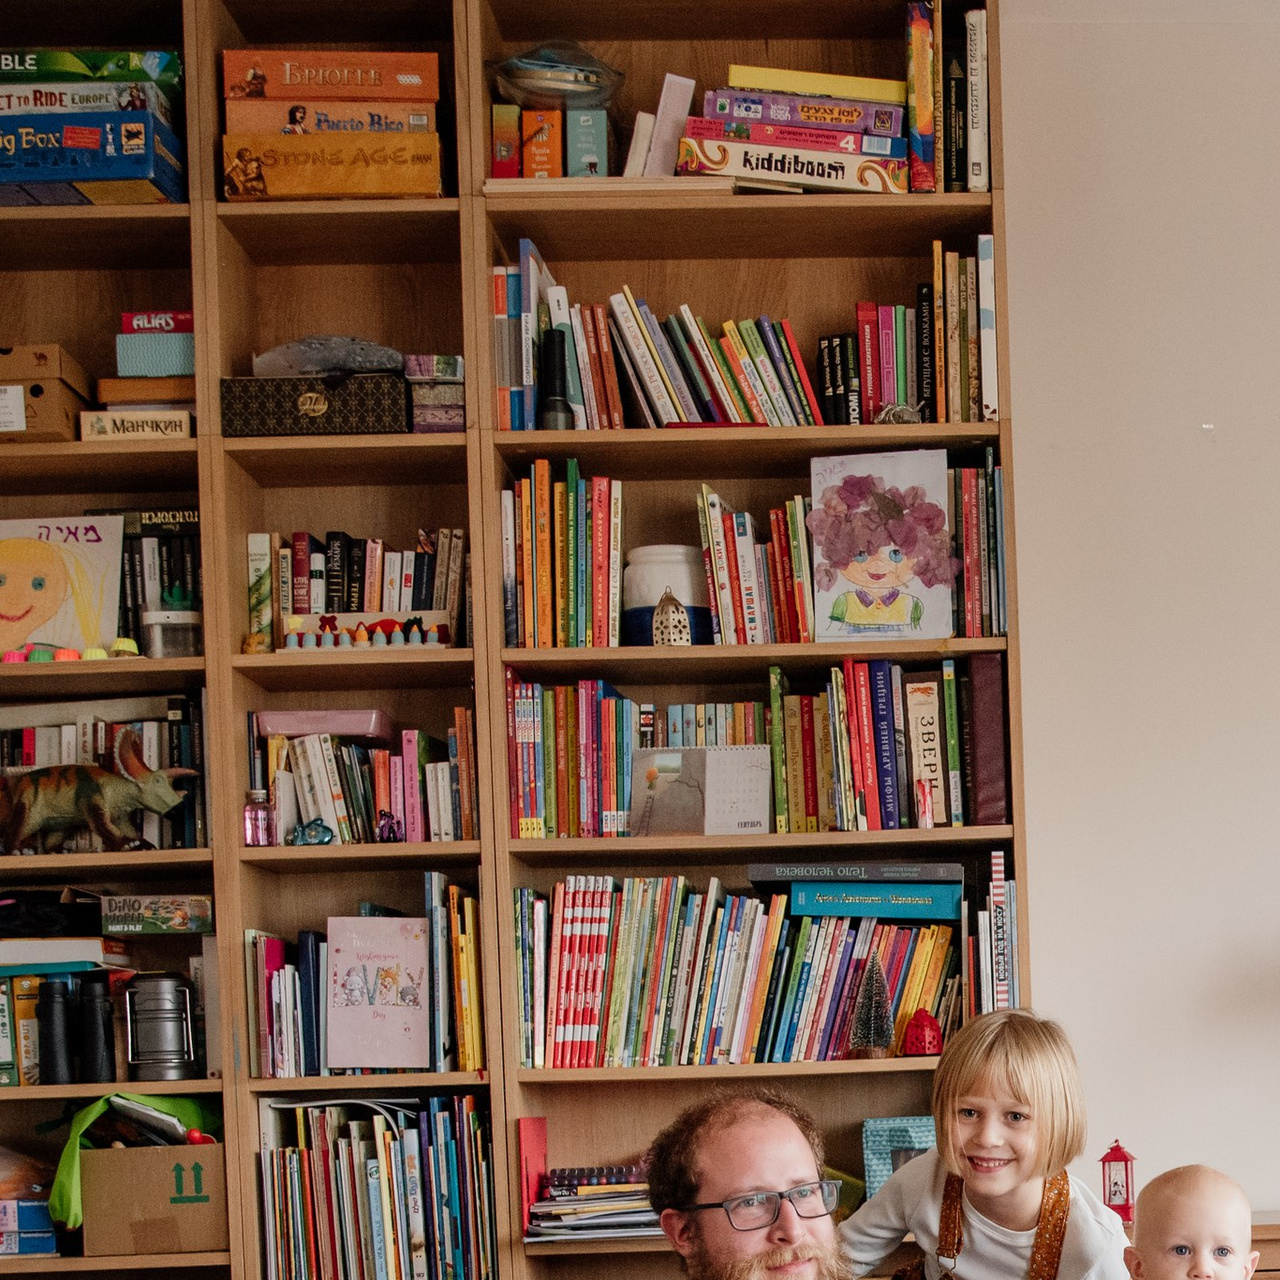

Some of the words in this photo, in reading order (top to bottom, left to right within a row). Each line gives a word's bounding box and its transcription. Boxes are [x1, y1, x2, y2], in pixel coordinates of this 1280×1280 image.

[969, 22, 978, 64] PICASSOS
[970, 67, 979, 77] IN
[32, 89, 68, 108] RIDE
[70, 92, 112, 105] EUROPE
[970, 80, 980, 130] BARCELONA
[314, 110, 365, 133] Puerto
[367, 110, 404, 133] Rico
[934, 90, 943, 145] SCOTLAND
[17, 127, 61, 149] Box
[838, 134, 857, 152] 4
[260, 148, 345, 168] STONE
[350, 146, 409, 169] AGE
[522, 313, 530, 336] ИВРИТА
[921, 301, 930, 346] ВОЛКАМИ
[863, 324, 872, 366] ПСИХОТЕРАПИЯ
[523, 336, 532, 384] СОВРЕМЕННОГО
[865, 365, 874, 397] ГРУППОВАЯ
[922, 356, 932, 398] БЕГУЩАЯ
[111, 417, 184, 436] Манчкин
[332, 540, 342, 571] РЕМАРК
[716, 548, 726, 572] ЗОКИ
[350, 581, 360, 611] ТЕРРИ
[744, 585, 757, 624] МАРШАК
[748, 623, 758, 631] С.
[876, 671, 887, 715] ГРЕЦИИ
[788, 724, 800, 766] Винни-Пух
[821, 712, 831, 755] ЧЕЛОВЕКА
[877, 720, 892, 771] ДРЕВНЕЙ
[883, 776, 894, 812] МИФЫ
[775, 866, 834, 878] человека
[836, 866, 868, 878] Тело
[995, 907, 1003, 927] НОСУ
[996, 927, 1004, 939] НА
[996, 939, 1004, 954] ГОД
[996, 954, 1005, 980] НОВЫЙ
[372, 1010, 386, 1021] Day
